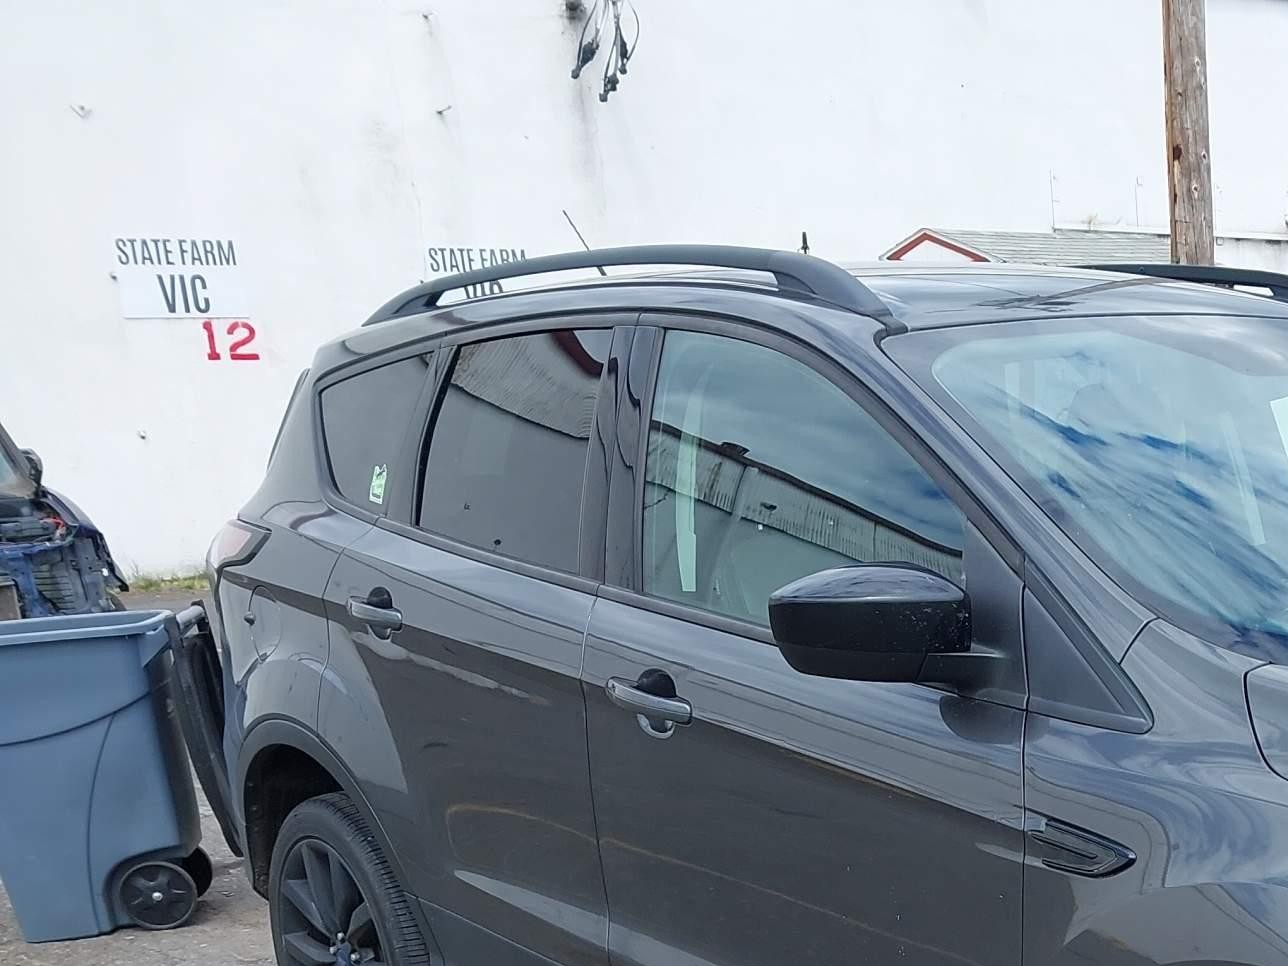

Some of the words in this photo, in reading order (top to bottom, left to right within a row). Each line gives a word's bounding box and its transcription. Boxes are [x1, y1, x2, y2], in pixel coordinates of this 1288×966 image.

[115, 238, 175, 266] STATE
[178, 239, 237, 266] FARM
[428, 247, 475, 273] STATE
[156, 273, 211, 314] VIC
[202, 320, 260, 361] 12
